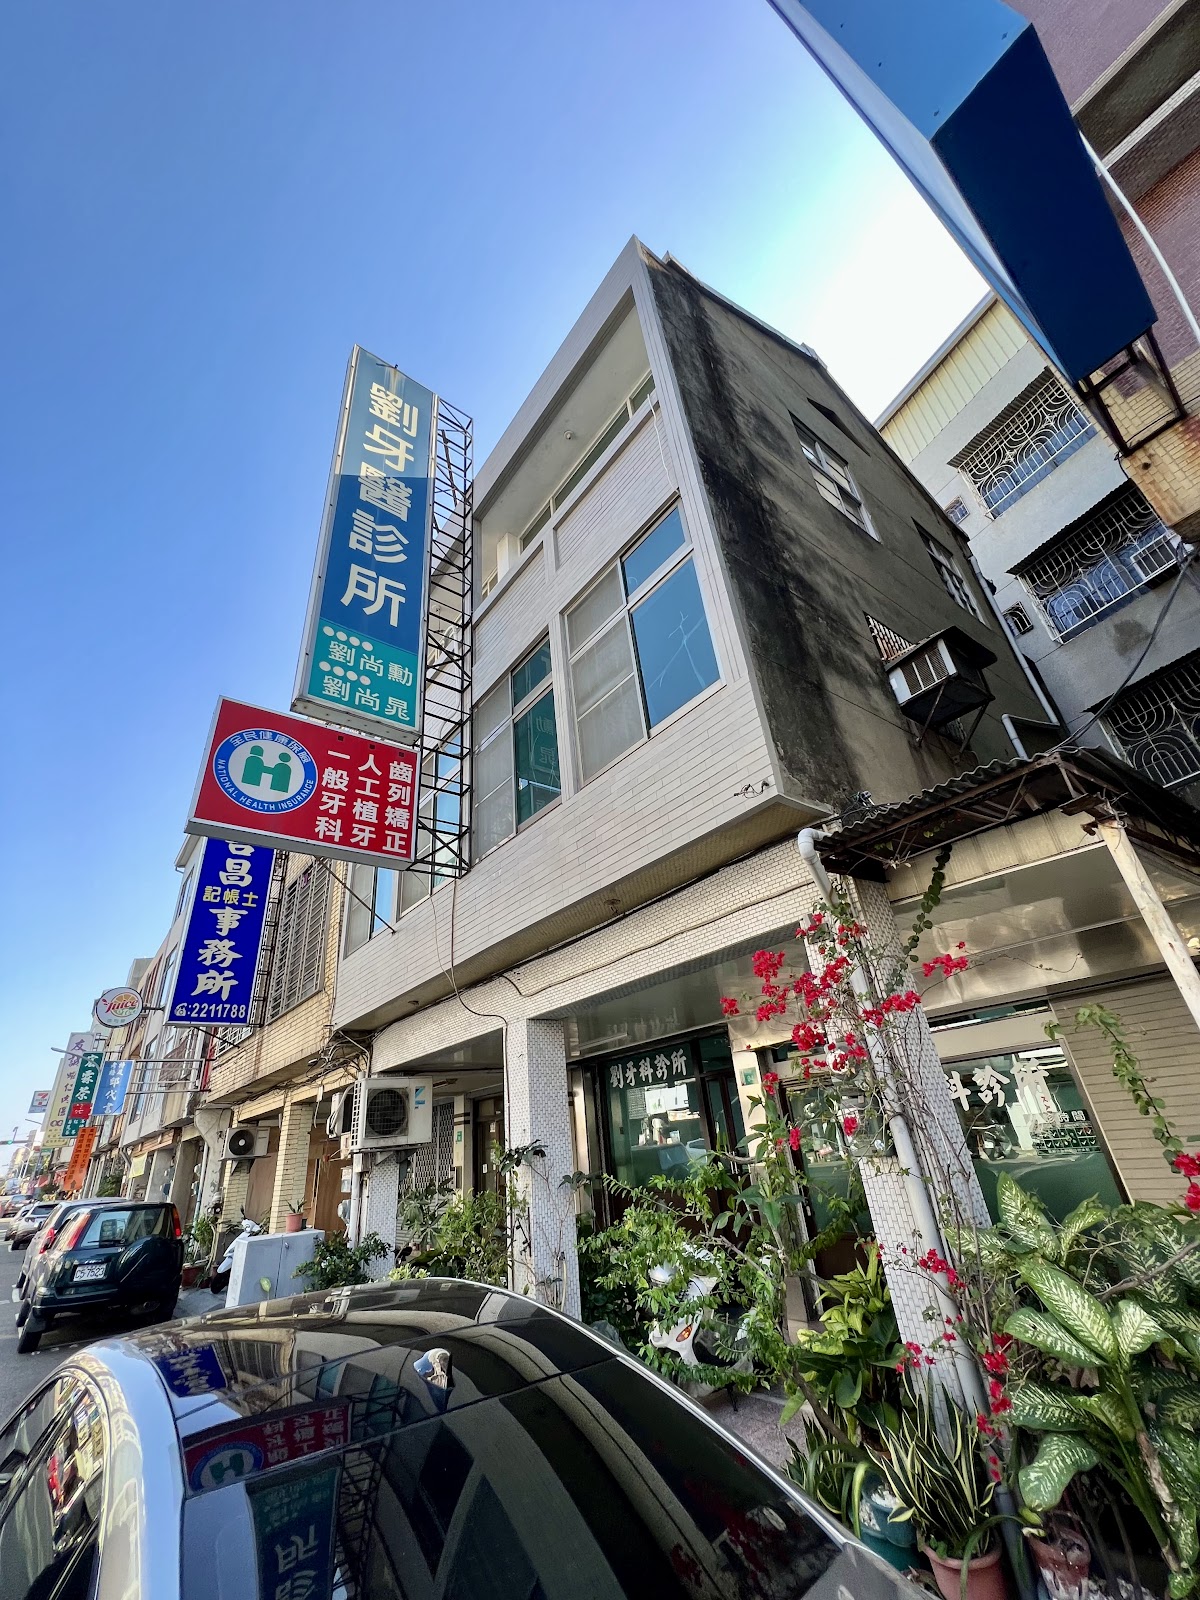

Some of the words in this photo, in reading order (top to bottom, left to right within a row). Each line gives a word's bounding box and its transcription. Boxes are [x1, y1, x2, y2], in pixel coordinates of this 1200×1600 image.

[340, 381, 420, 628] 劉牙醫診所
[216, 758, 238, 798] NATIONAL
[239, 795, 276, 811] HEALTH
[278, 779, 314, 810] INSURANCE
[315, 750, 351, 843] 一般牙科
[350, 754, 382, 847] 人工植牙
[382, 761, 414, 855] 齒列矯正
[202, 885, 259, 907] 記帳士
[190, 906, 249, 1002] 事務所
[610, 1049, 687, 1089] 劉牙科診所
